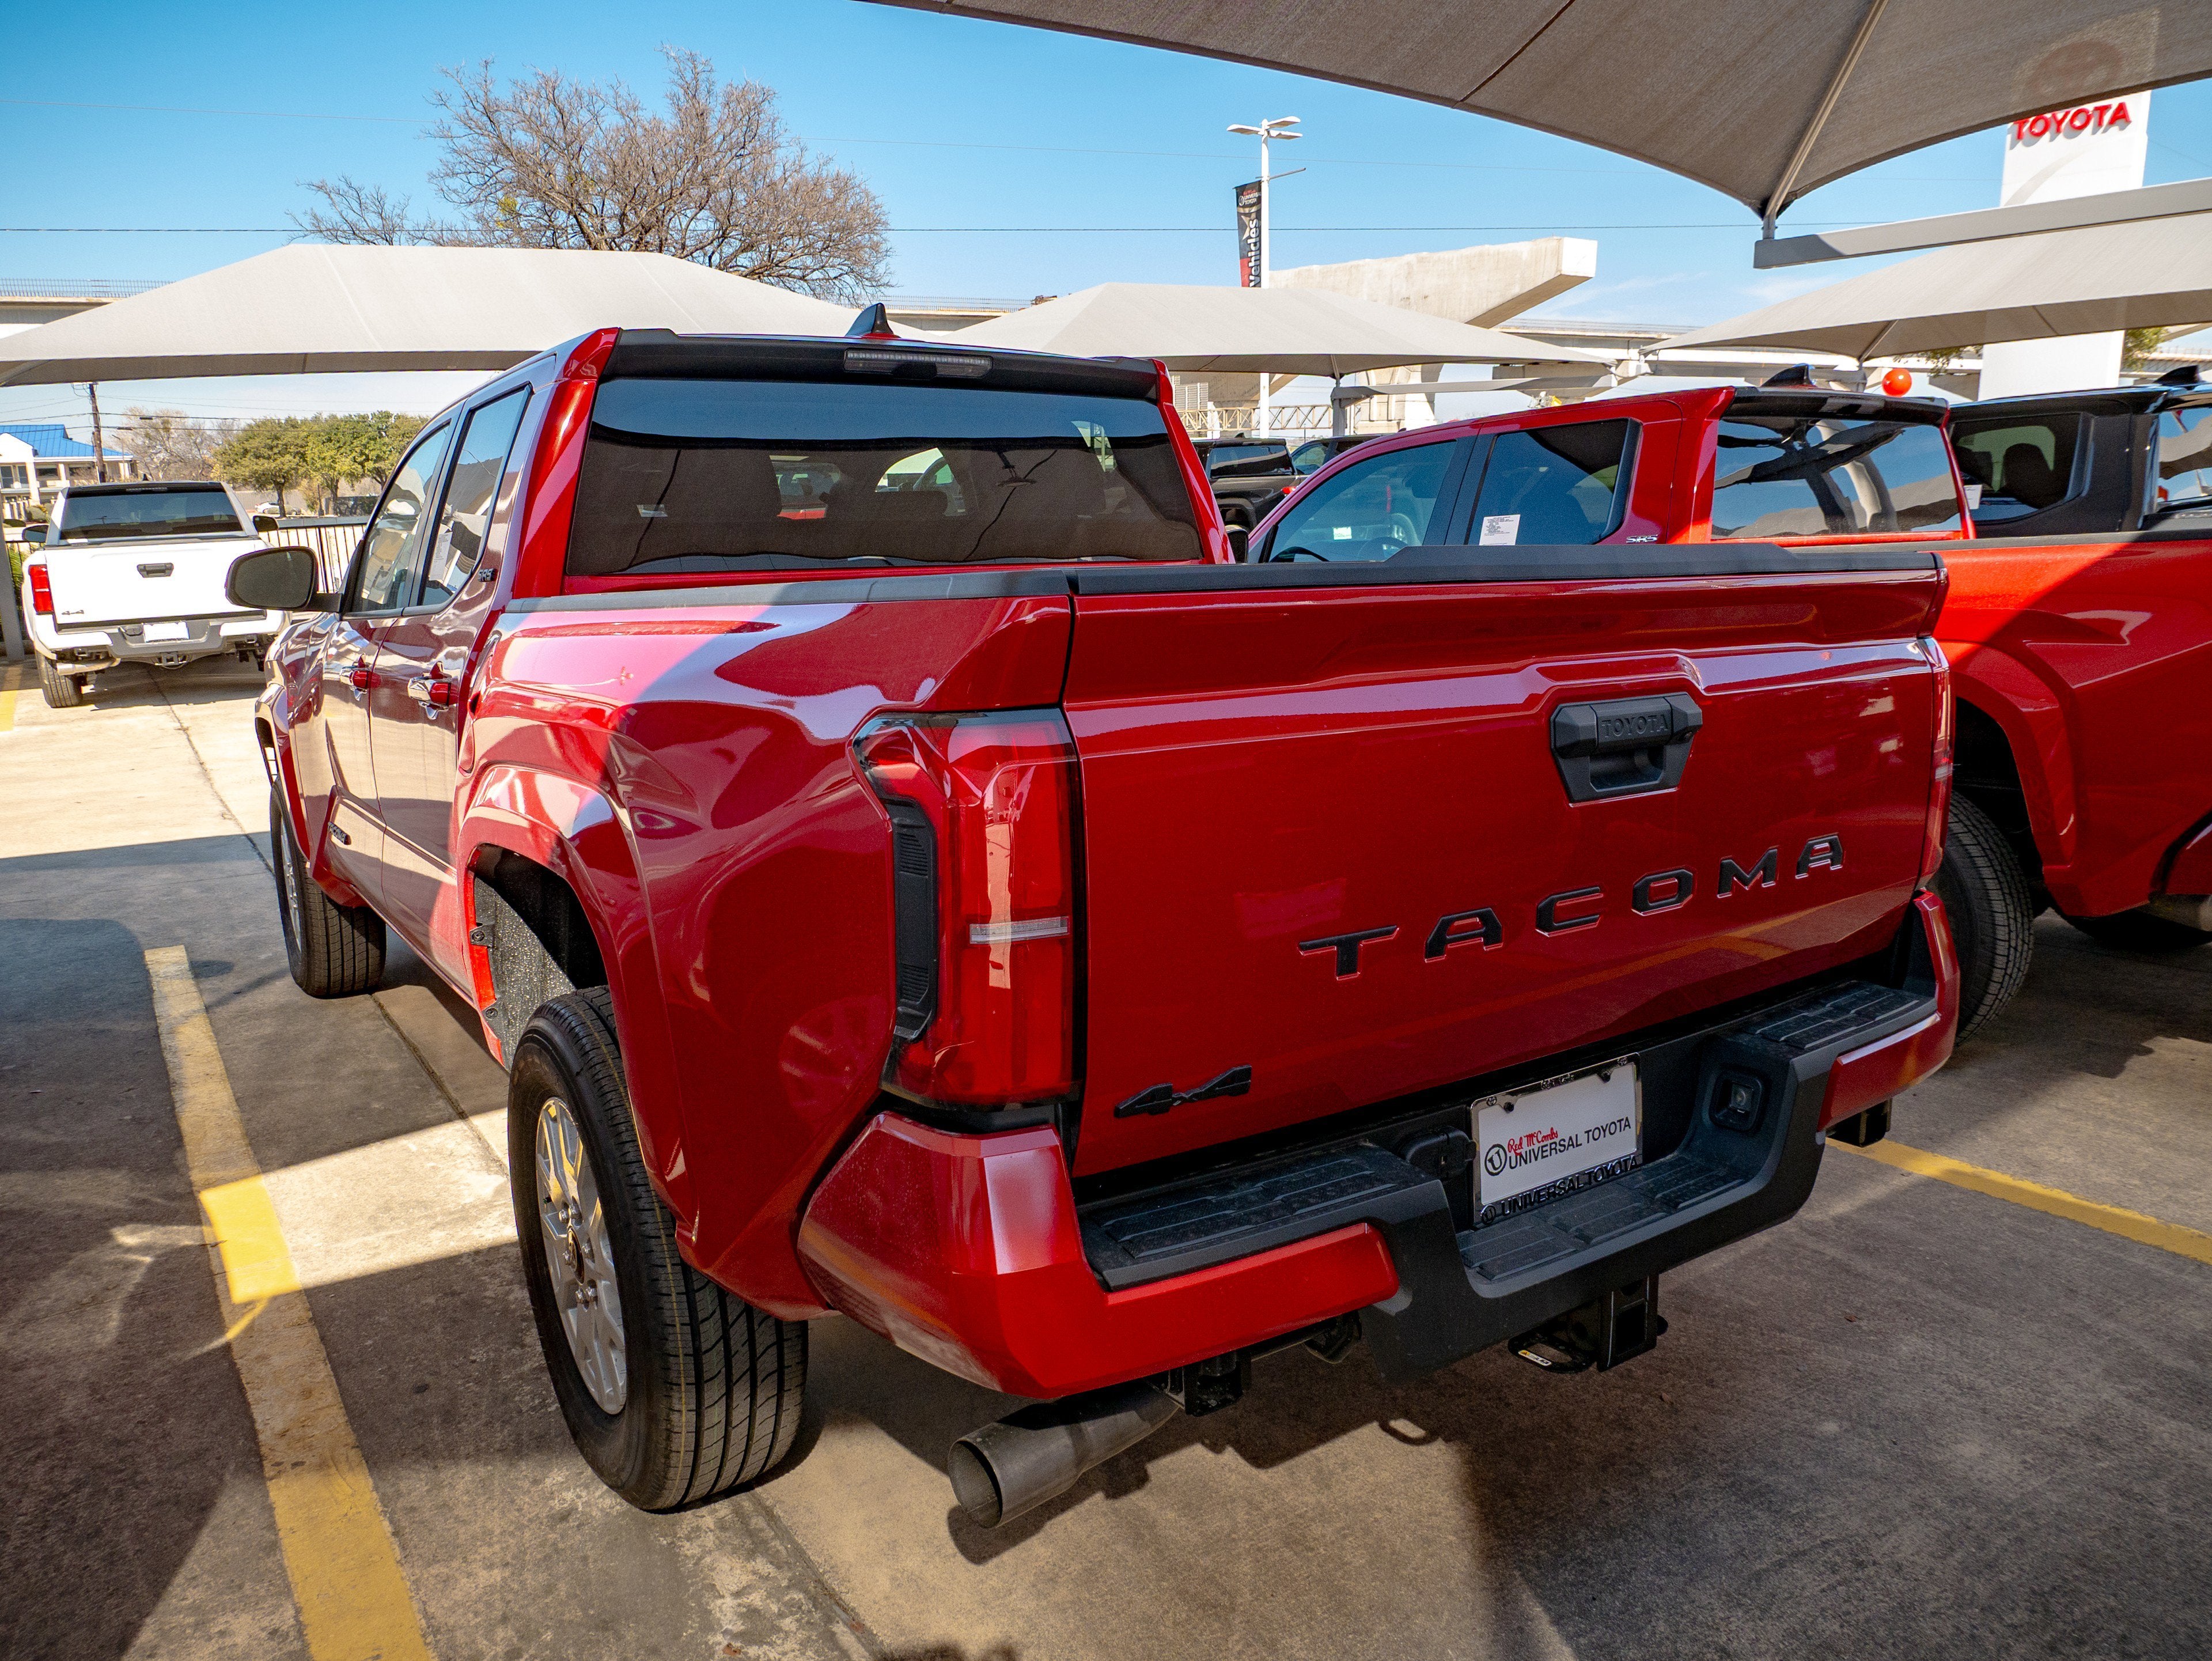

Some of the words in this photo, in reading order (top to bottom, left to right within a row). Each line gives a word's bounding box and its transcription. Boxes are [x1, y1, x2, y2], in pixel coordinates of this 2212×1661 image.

[2013, 102, 2132, 140] TOYOTA
[1247, 218, 1260, 287] Vehicles
[1601, 714, 1669, 737] TOYOTA
[1297, 833, 1844, 981] TACOMA
[1508, 1136, 1524, 1156] Red
[1524, 1127, 1558, 1148] McCombs
[1509, 1134, 1582, 1170] UNIVERSAL
[1584, 1117, 1631, 1144] TOYOTA
[1501, 1174, 1584, 1216] UNIVERSAL
[1585, 1155, 1637, 1185] TOYOTA
